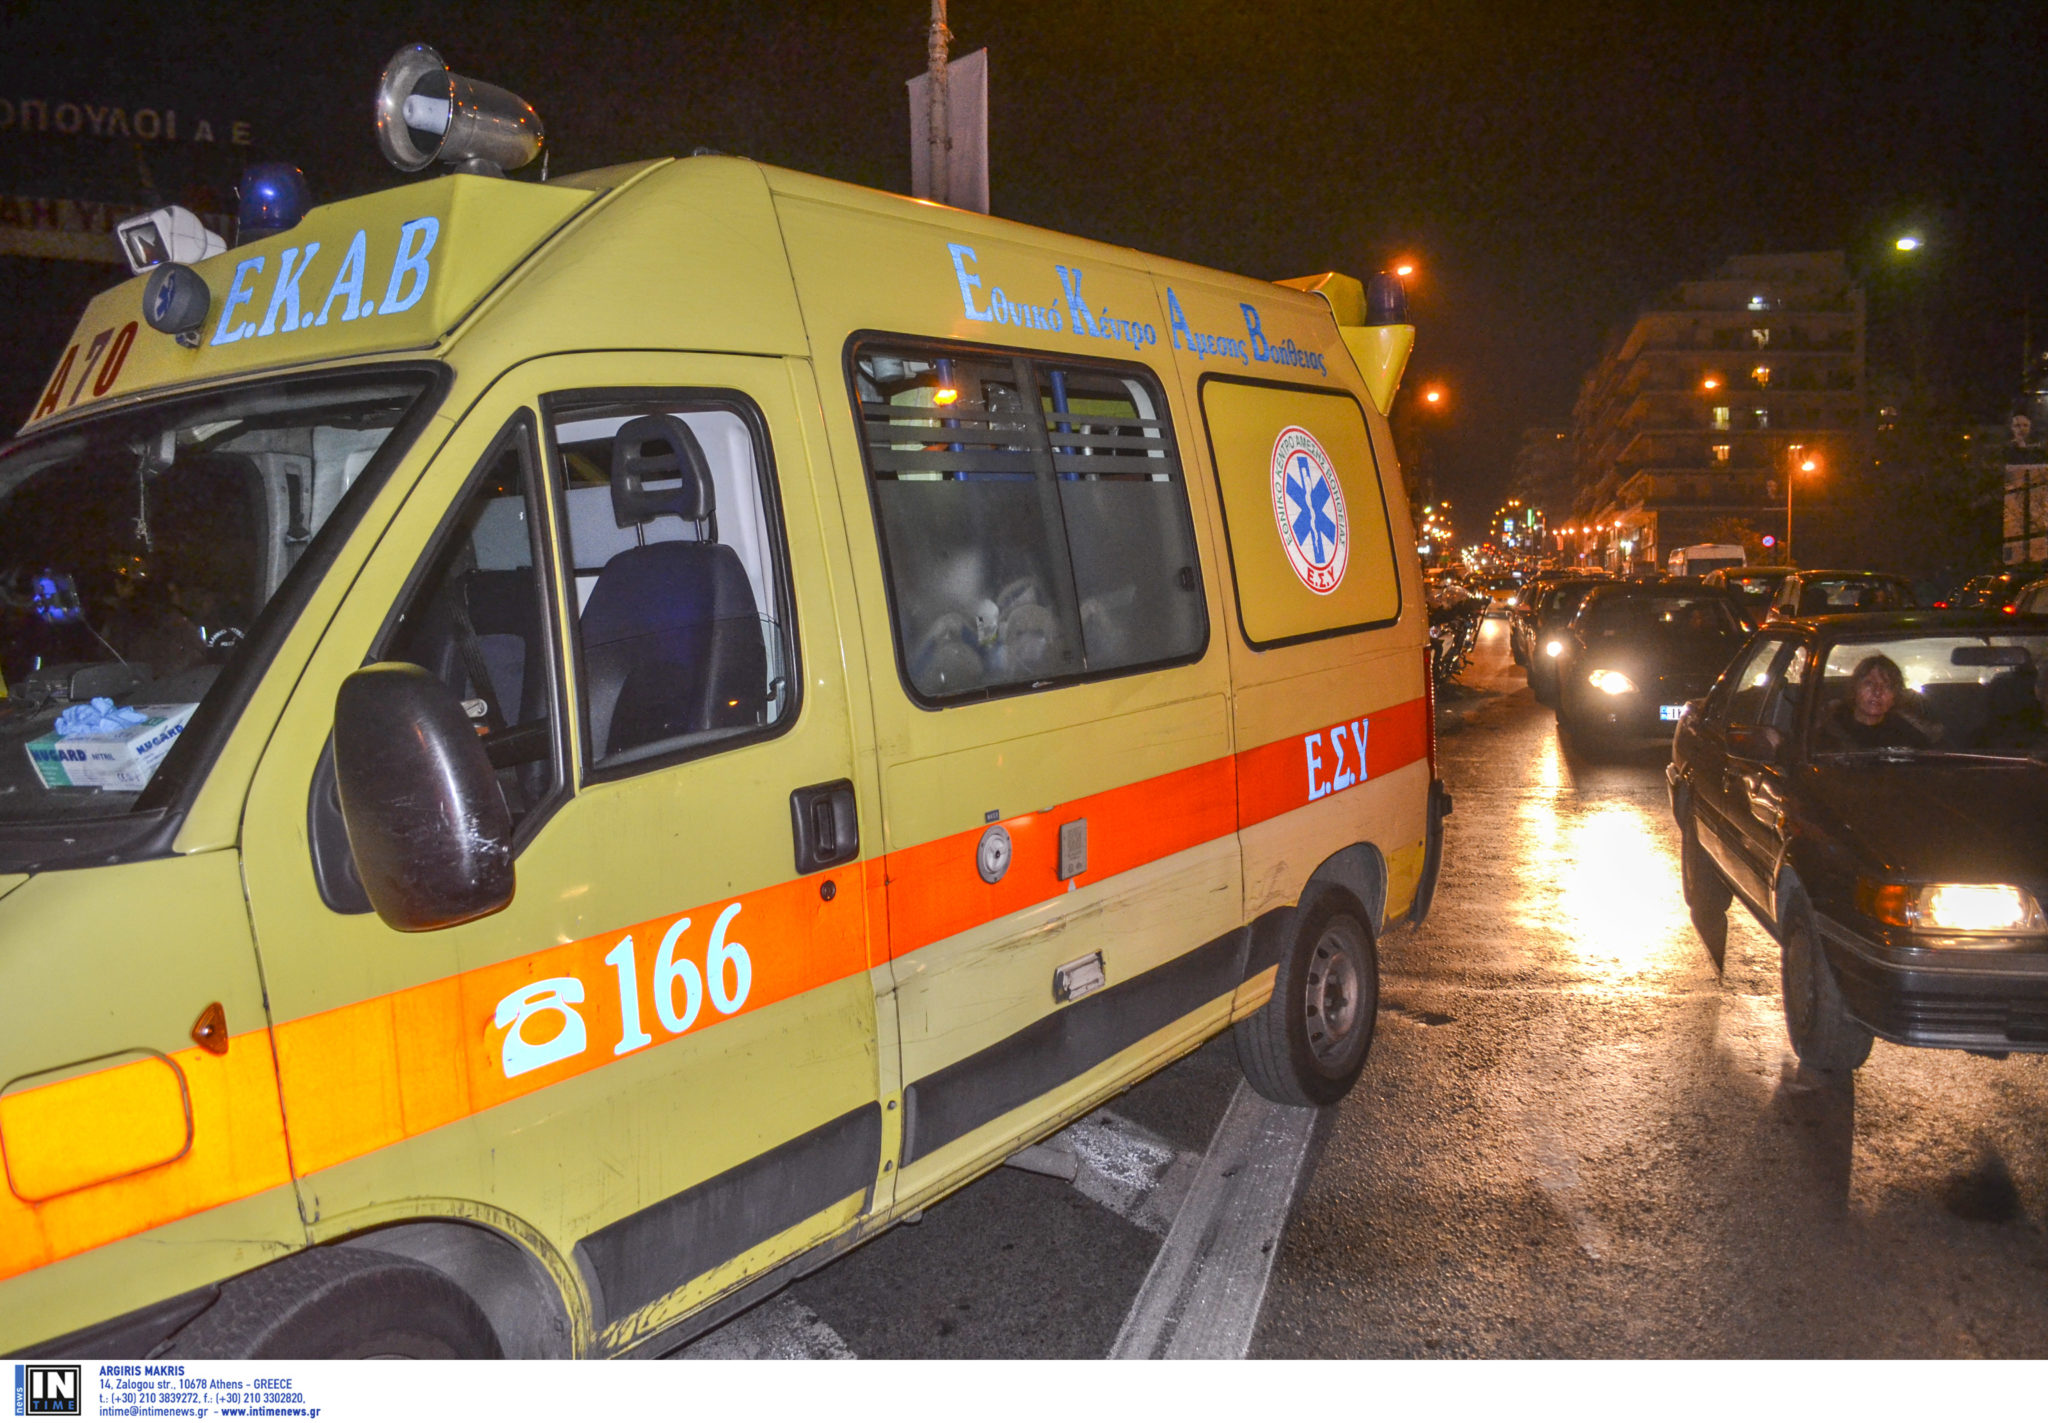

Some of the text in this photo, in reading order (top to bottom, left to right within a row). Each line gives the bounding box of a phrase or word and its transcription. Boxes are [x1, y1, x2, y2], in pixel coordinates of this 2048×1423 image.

[210, 216, 441, 347] Ε.Κ.Α.Β
[947, 243, 1063, 333] Εθνικό
[1055, 265, 1157, 351] Κέντρο
[1239, 303, 1328, 378] Βοήθειας
[1275, 435, 1295, 479] ΚΕΝΤΡΟ
[1295, 435, 1326, 470] ΑΜΕΣΗΣ
[1275, 481, 1293, 546] ΕΘΝΙΚΟ
[1307, 566, 1336, 588] Ε.Σ.Υ
[32, 749, 116, 762] NUGARD NITRIL
[136, 724, 185, 755] NUGARD
[1305, 719, 1370, 802] Ε.Σ.Υ
[604, 901, 753, 1056] 166
